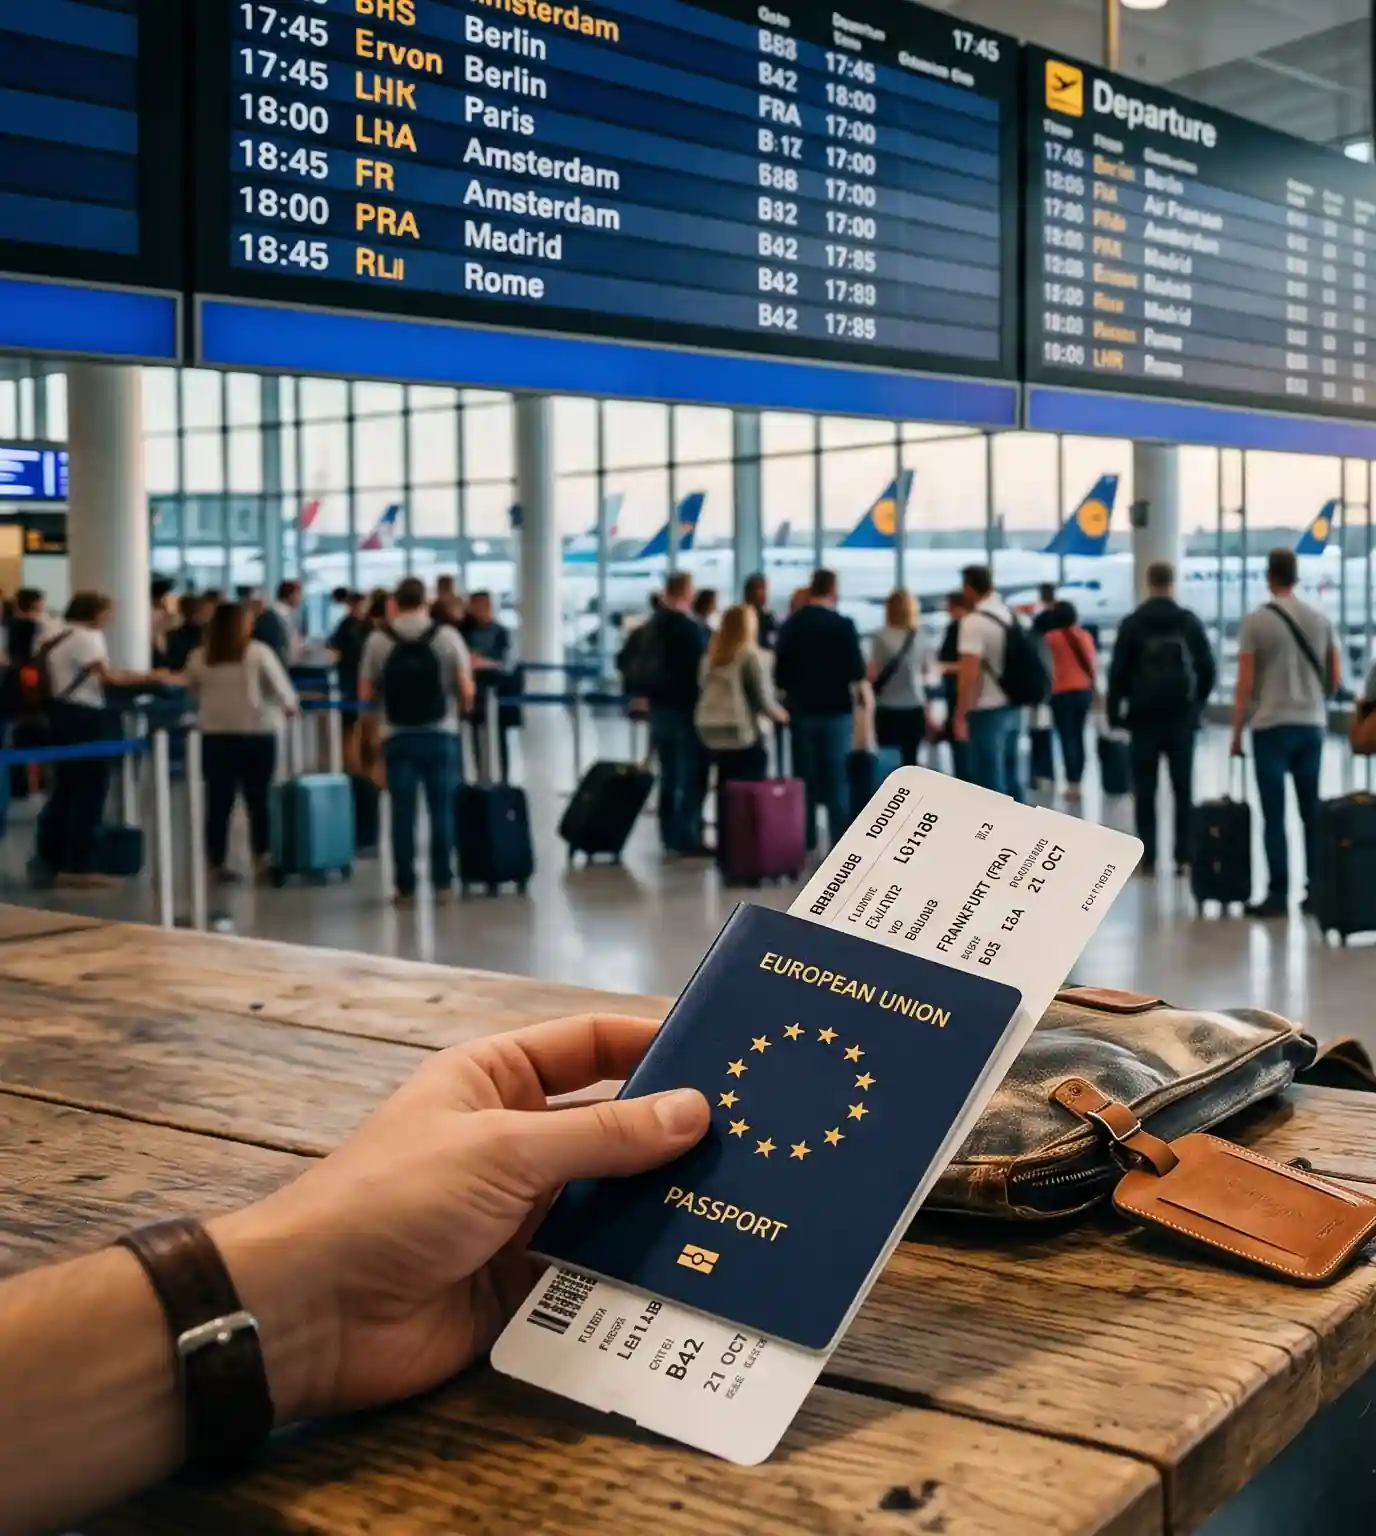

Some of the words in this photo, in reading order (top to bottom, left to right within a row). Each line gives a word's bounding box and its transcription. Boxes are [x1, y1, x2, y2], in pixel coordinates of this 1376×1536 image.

[239, 3, 329, 47] 17:45
[355, 28, 443, 75] Ervon
[464, 54, 548, 100] Berlin
[825, 146, 876, 175] 17:00
[464, 14, 547, 61] Berlin
[758, 94, 802, 128] FRA
[825, 114, 876, 145] 17:00
[758, 62, 798, 93] B42
[825, 82, 876, 114] 18:00
[825, 51, 876, 84] 17:45
[953, 29, 999, 63] 17:45
[239, 48, 329, 90] 17:45
[464, 96, 535, 136] Paris
[825, 178, 876, 207] 17:00
[1093, 79, 1217, 148] Departure
[239, 93, 329, 134] 18:00
[463, 137, 620, 191] Amsterdam
[825, 210, 876, 239] 17:00
[239, 139, 329, 180] 18:45
[355, 158, 395, 192] FR
[463, 180, 620, 231] Amsterdam
[758, 231, 798, 260] B42
[239, 186, 329, 225] 18:00
[355, 202, 420, 240] PRA
[464, 220, 562, 261] Madrid
[758, 267, 798, 295] B42
[239, 233, 329, 271] 18:45
[464, 262, 545, 299] Rome
[758, 303, 798, 330] B42
[936, 880, 991, 952] FRANKFURT
[985, 847, 1018, 880] (FRA)
[759, 952, 877, 1003] EUROPEAN
[879, 990, 951, 1028] UNION
[664, 1186, 788, 1242] PASSPORT
[666, 1338, 704, 1380] B42
[703, 1371, 726, 1393] 21
[720, 1332, 749, 1366] OCT
